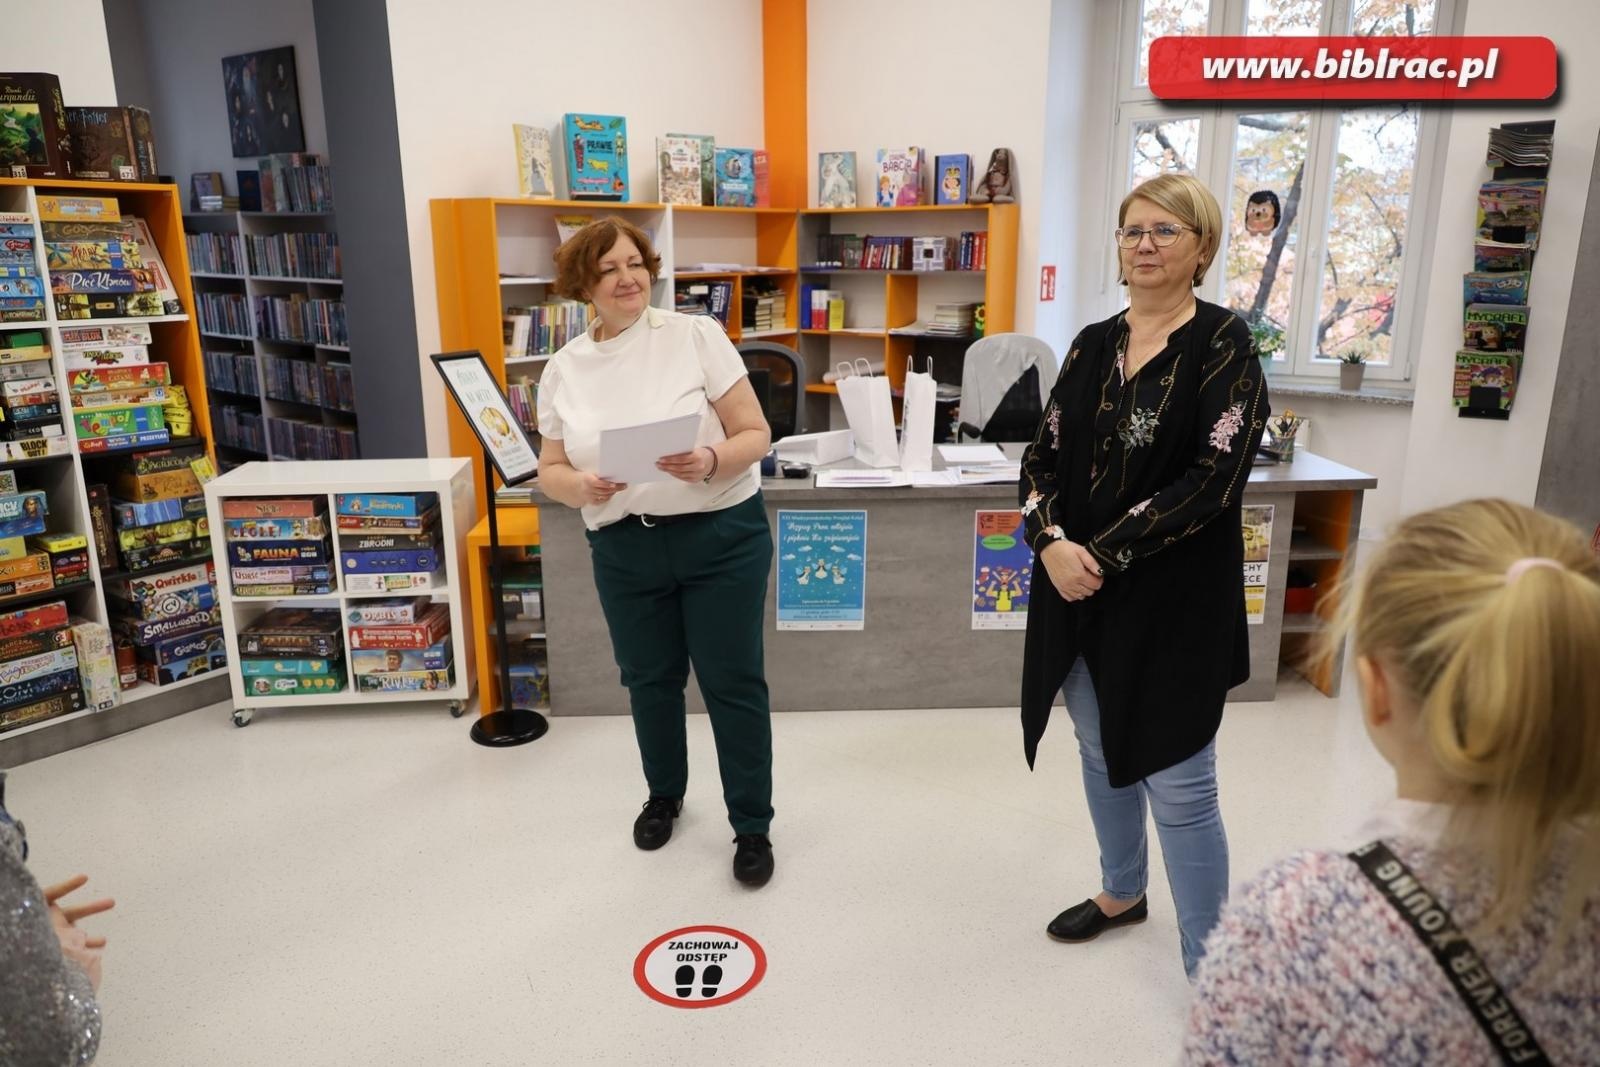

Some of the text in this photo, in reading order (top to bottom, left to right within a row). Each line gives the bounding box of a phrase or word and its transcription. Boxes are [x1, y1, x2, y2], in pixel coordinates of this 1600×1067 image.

[882, 159, 912, 173] BABCIA
[20, 440, 48, 451] BLOCK
[359, 539, 394, 548] ZBRODNI
[253, 547, 299, 559] FAUNA
[155, 572, 197, 589] Qwirkle
[668, 941, 739, 950] ZACHOWAJ
[676, 953, 728, 963] ODSTĘP
[1376, 860, 1538, 1063] FOREVER YOUNG
